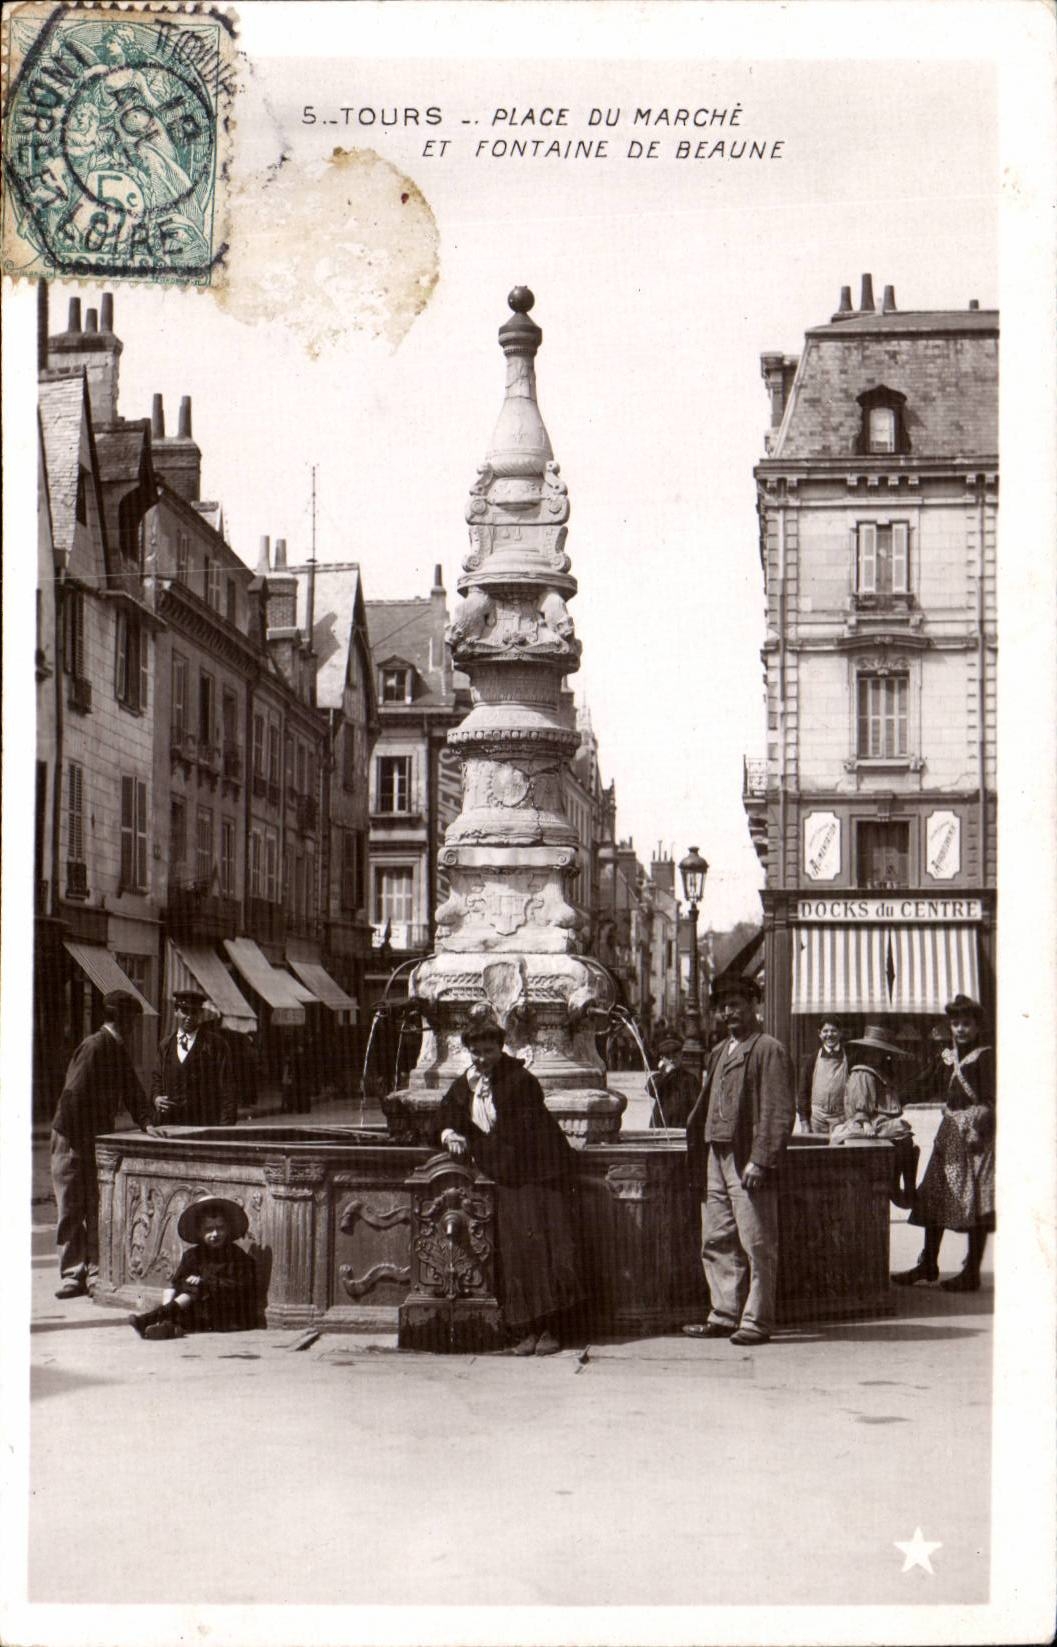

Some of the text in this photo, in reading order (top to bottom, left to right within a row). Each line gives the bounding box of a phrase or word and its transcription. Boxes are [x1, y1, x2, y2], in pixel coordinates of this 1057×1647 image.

[801, 901, 977, 917] DOCKS du CENTRE
